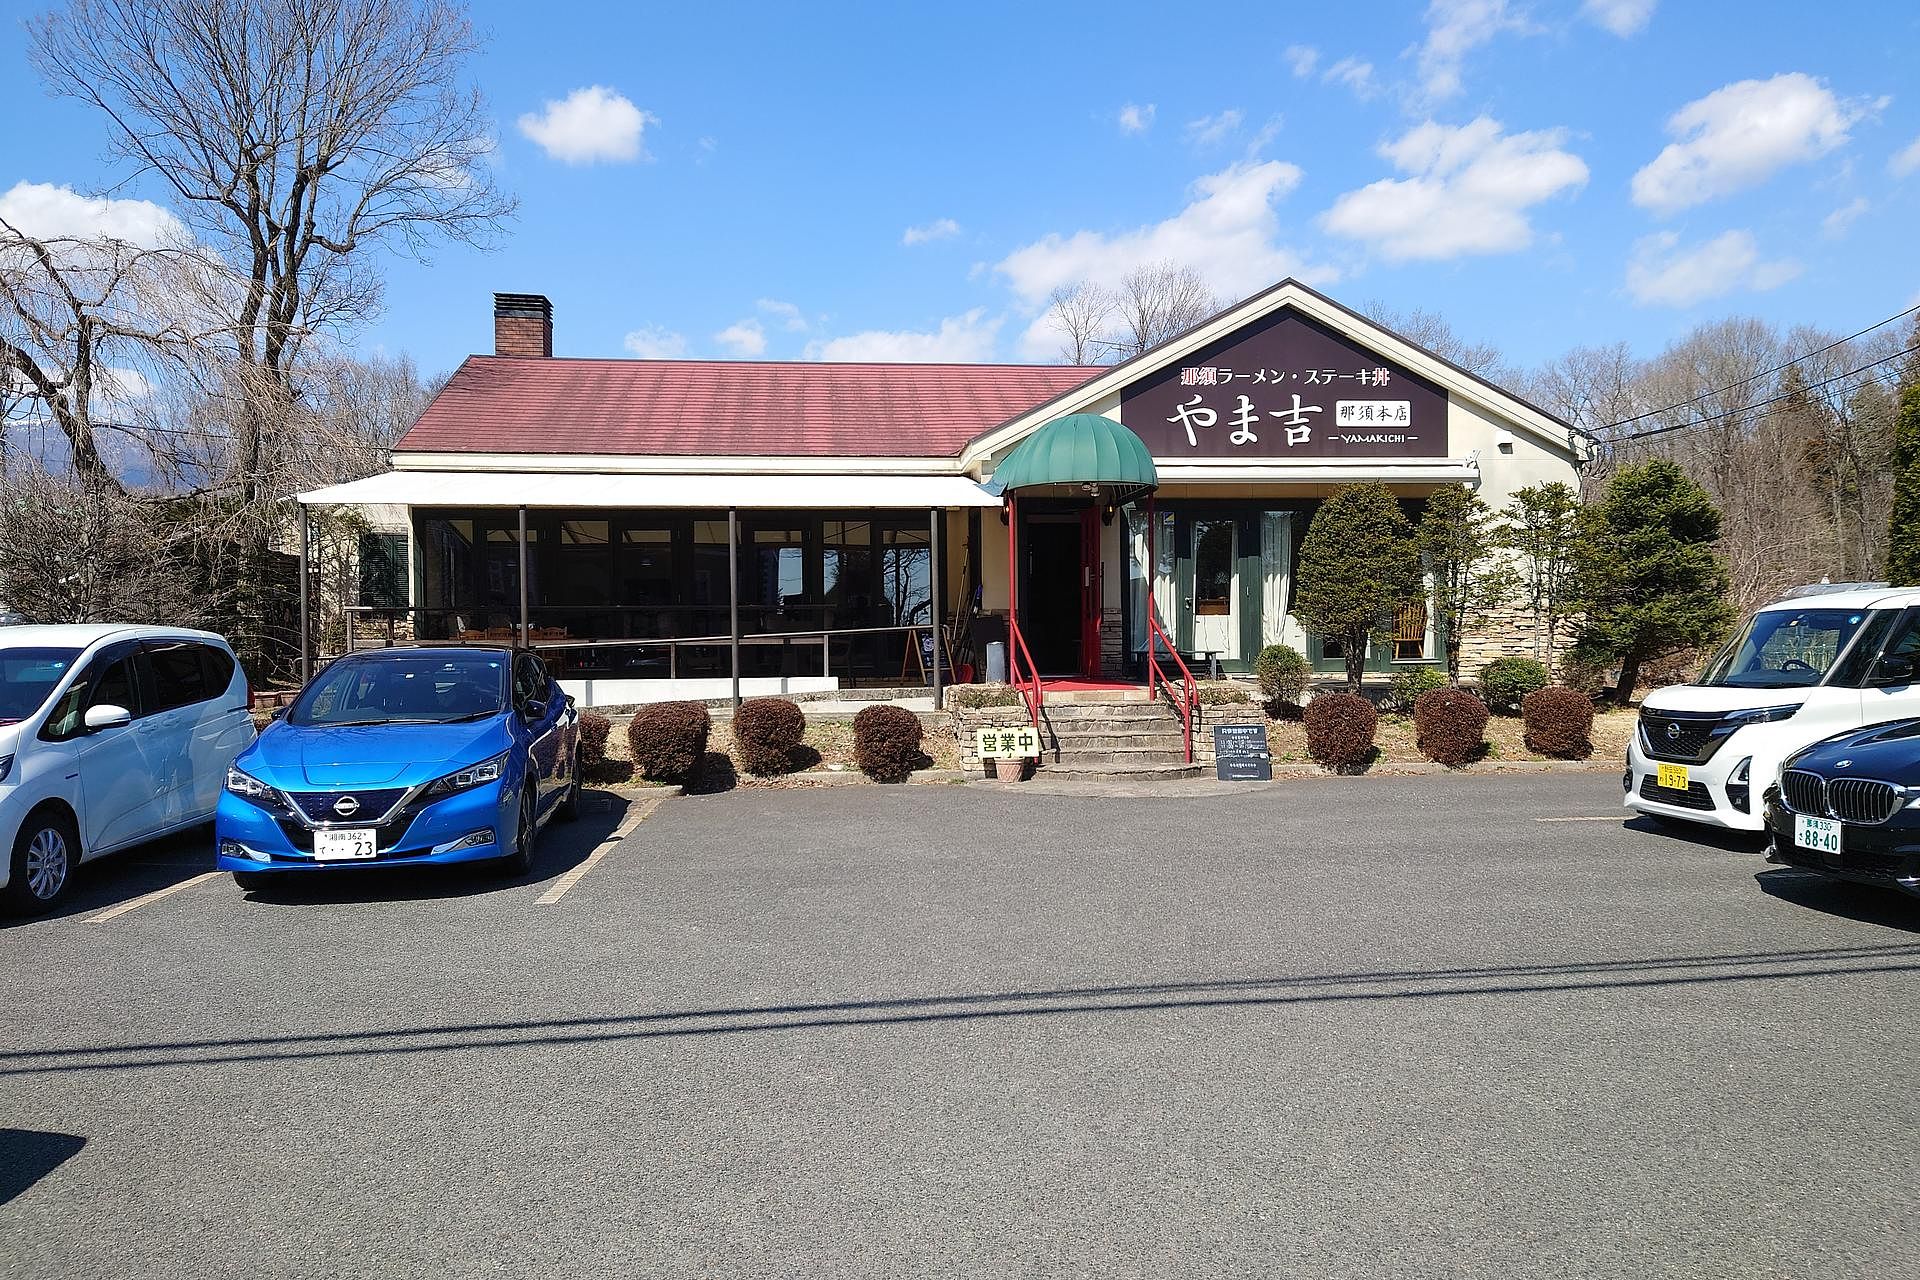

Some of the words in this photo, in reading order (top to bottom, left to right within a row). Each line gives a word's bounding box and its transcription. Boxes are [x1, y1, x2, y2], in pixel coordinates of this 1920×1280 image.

[1166, 394, 1323, 447] やま吉
[1340, 405, 1407, 421] 那須本店
[982, 732, 1034, 752] 営業中
[347, 832, 362, 840] 362
